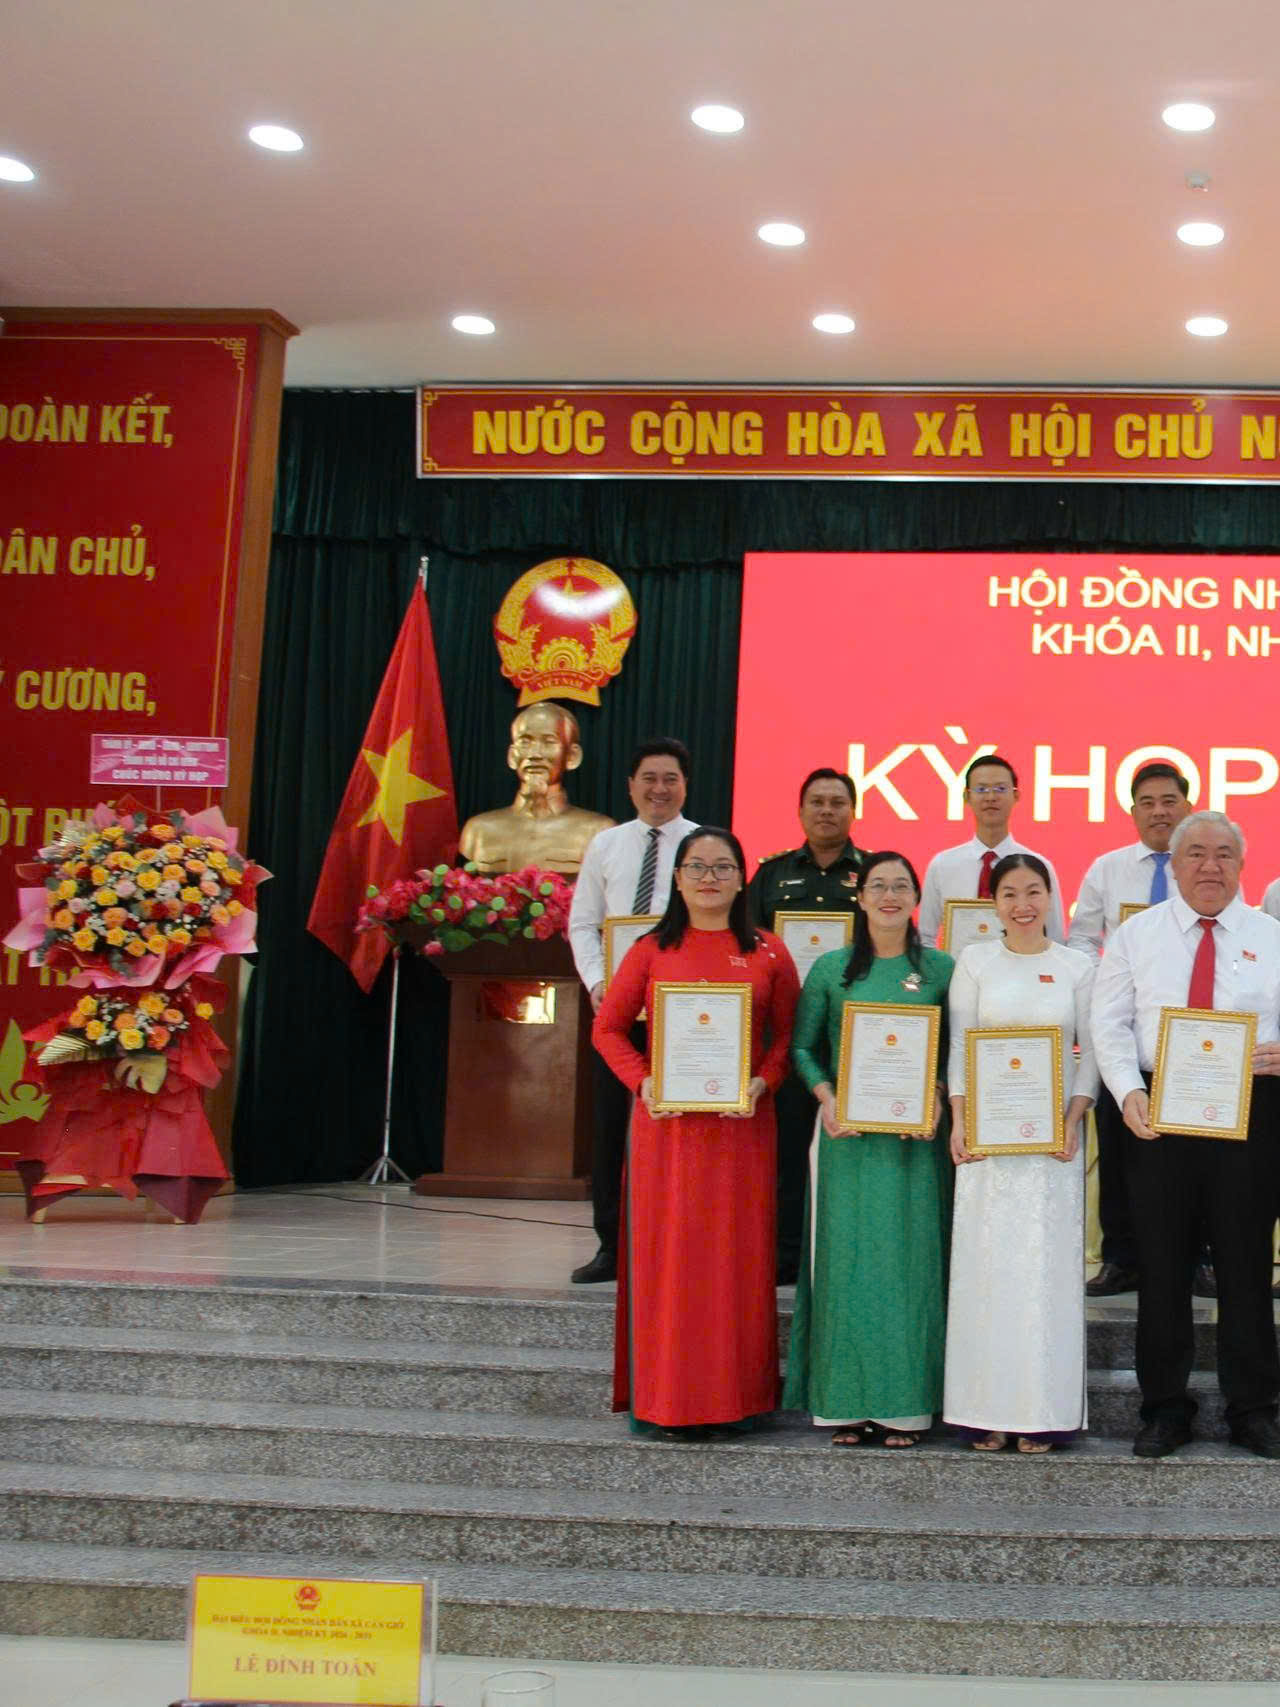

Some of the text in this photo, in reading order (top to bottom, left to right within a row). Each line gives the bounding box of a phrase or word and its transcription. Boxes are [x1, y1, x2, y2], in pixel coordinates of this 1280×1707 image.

[99, 393, 173, 448] KẾT,
[472, 399, 605, 455] NƯỚC
[630, 401, 764, 465] CỘNG
[787, 401, 887, 456] HÒA
[912, 404, 983, 457] XÃ
[1010, 403, 1091, 466] HỘI
[1114, 399, 1213, 459] CHỦ
[0, 524, 156, 581] ÂN CHỦ,
[988, 568, 1068, 616] HỘI
[1080, 566, 1220, 609] ĐỒNG
[1032, 615, 1164, 656] KHÓA
[1176, 624, 1212, 661] II,
[15, 667, 157, 716] CƯƠNG,
[848, 725, 998, 821] KỲ
